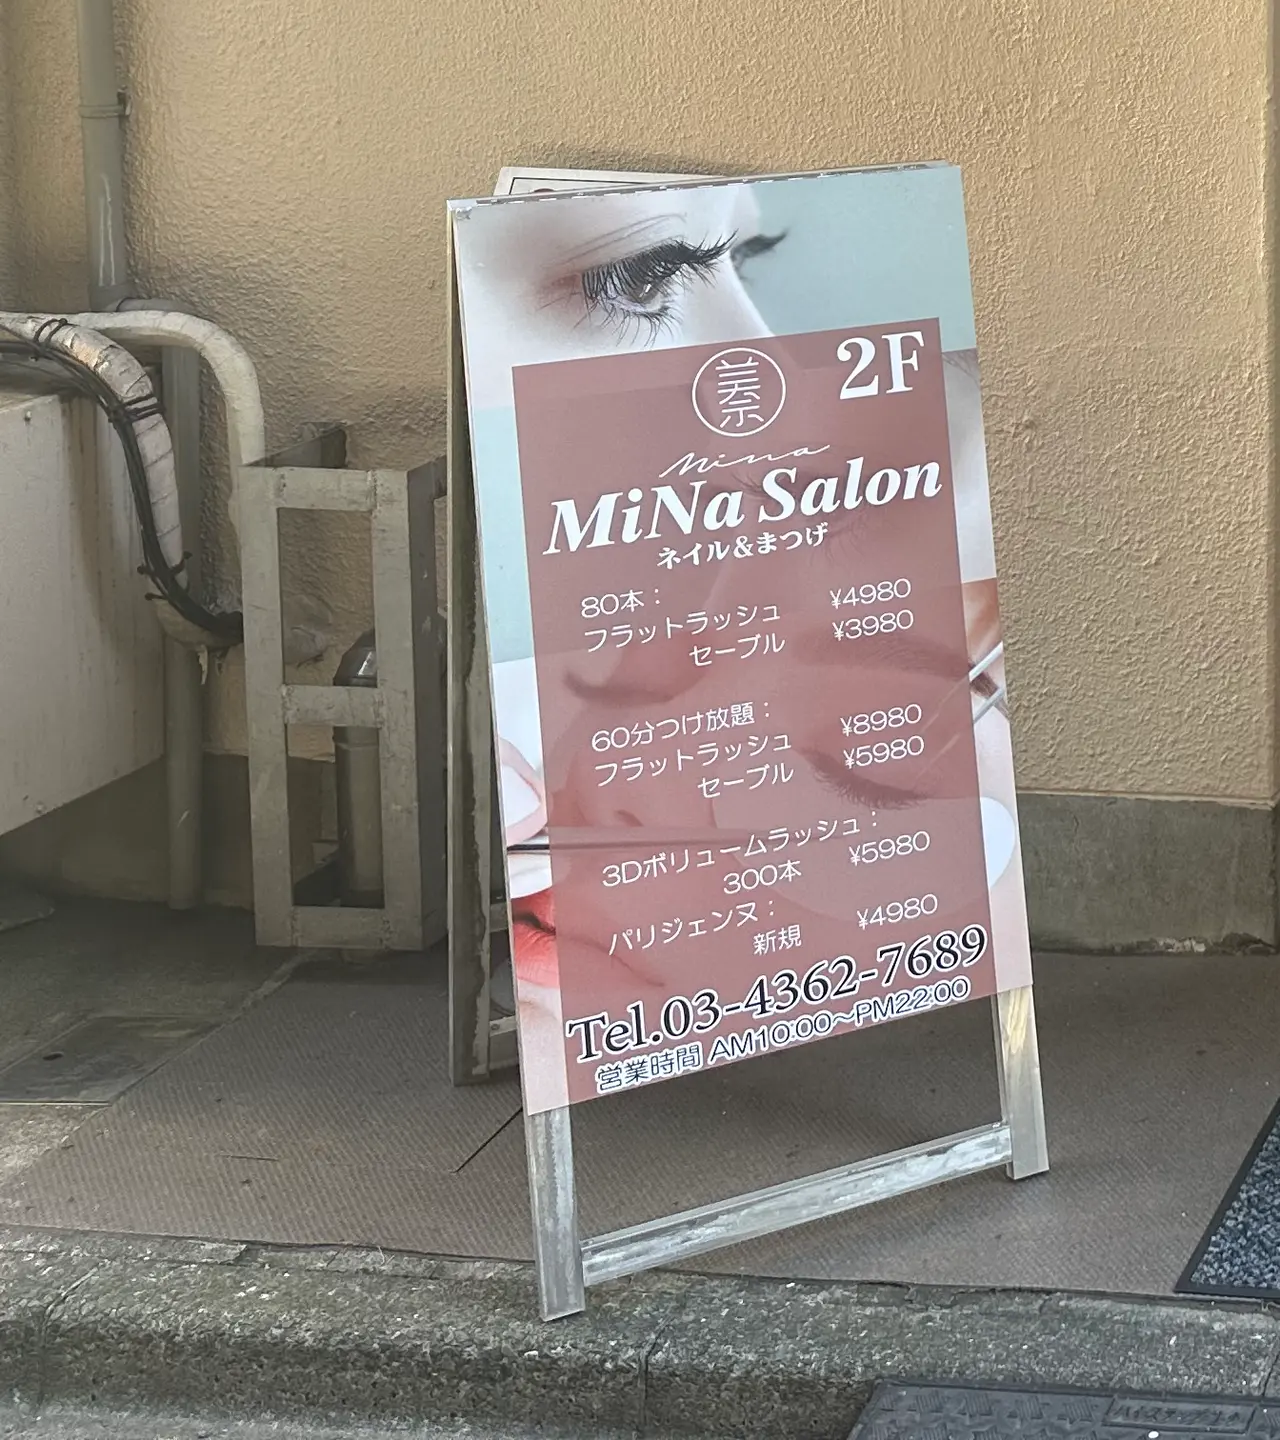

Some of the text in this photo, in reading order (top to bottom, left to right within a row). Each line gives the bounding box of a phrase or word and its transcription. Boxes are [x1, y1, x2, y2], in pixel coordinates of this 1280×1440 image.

[834, 330, 925, 400] 2F
[542, 457, 943, 556] MiNa Salon
[657, 522, 829, 570] ネイル&まつげ
[829, 578, 911, 609] ¥4980
[584, 604, 781, 653] フラットラッシュ
[832, 609, 914, 641] ¥3980
[689, 635, 786, 668] セーブル
[840, 703, 922, 736] ¥8980
[595, 734, 793, 787] フラットラッシュ
[843, 735, 925, 769] ¥5980
[698, 763, 795, 800] セーブル
[849, 830, 931, 866] ¥5980
[723, 859, 802, 895] 300本
[857, 893, 939, 930] ¥4980
[753, 925, 803, 956] 新規
[567, 924, 988, 1064] Tel.03-4362-7689
[597, 1044, 702, 1092] 営業時間
